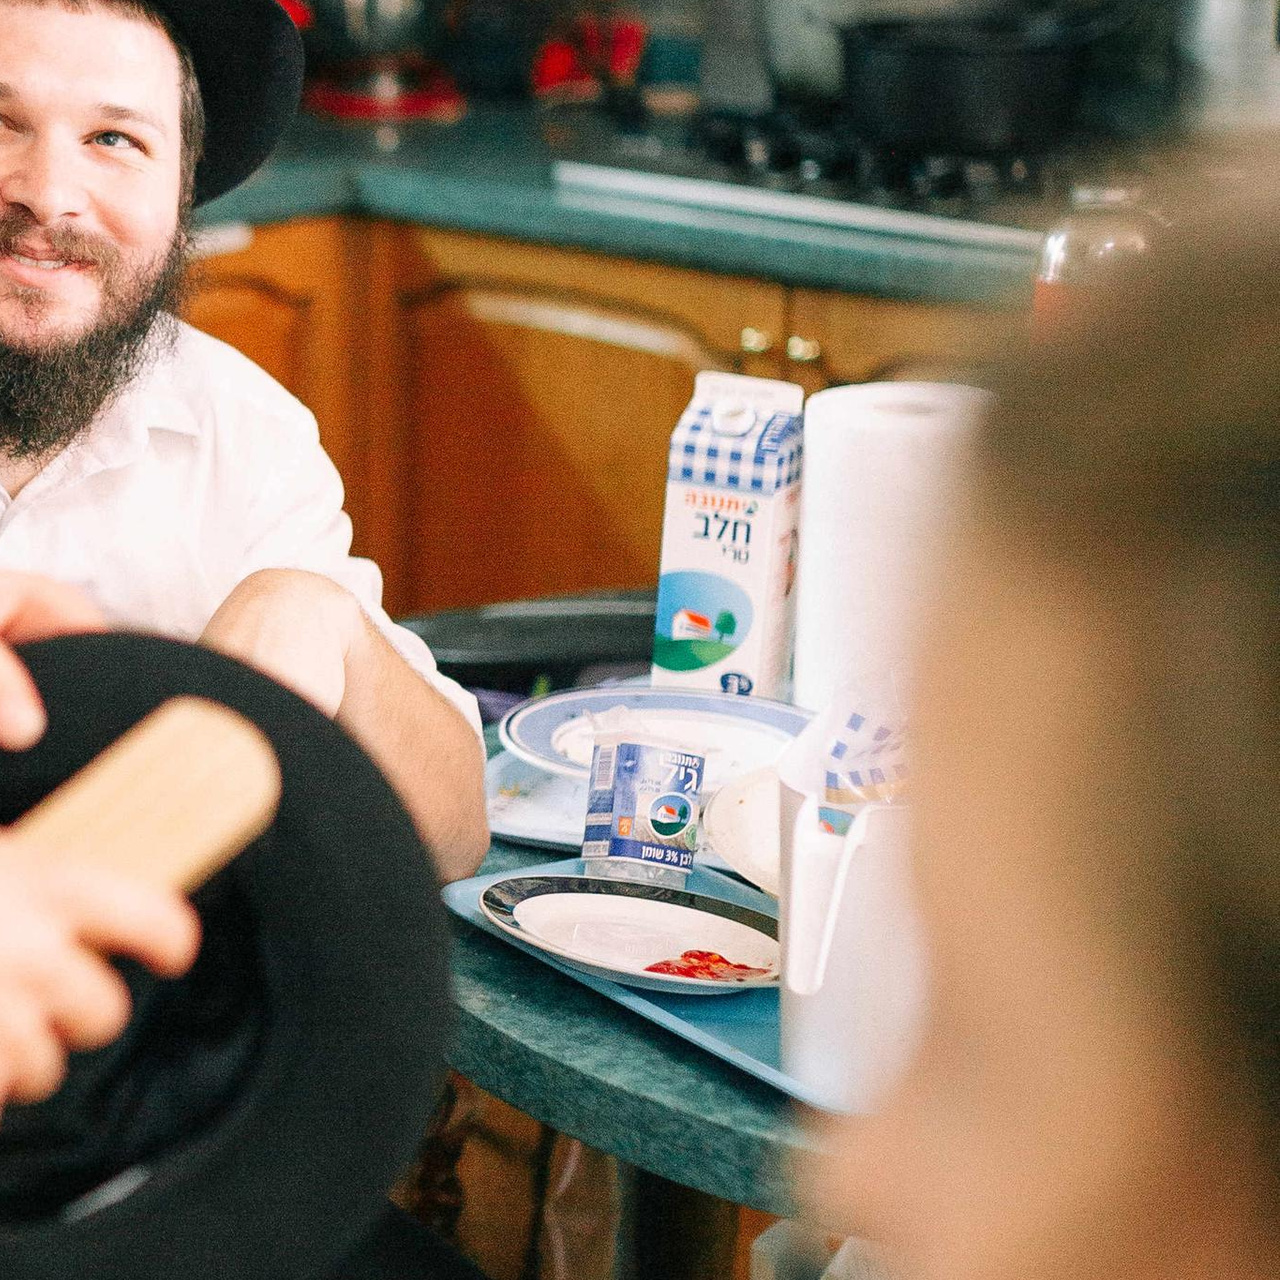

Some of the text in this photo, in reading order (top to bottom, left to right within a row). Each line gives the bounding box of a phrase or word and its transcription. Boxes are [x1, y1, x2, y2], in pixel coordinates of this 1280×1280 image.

[694, 511, 751, 543] חלב
[664, 766, 698, 791] גיל
[641, 845, 665, 859] שומן
[665, 849, 678, 863] 3%
